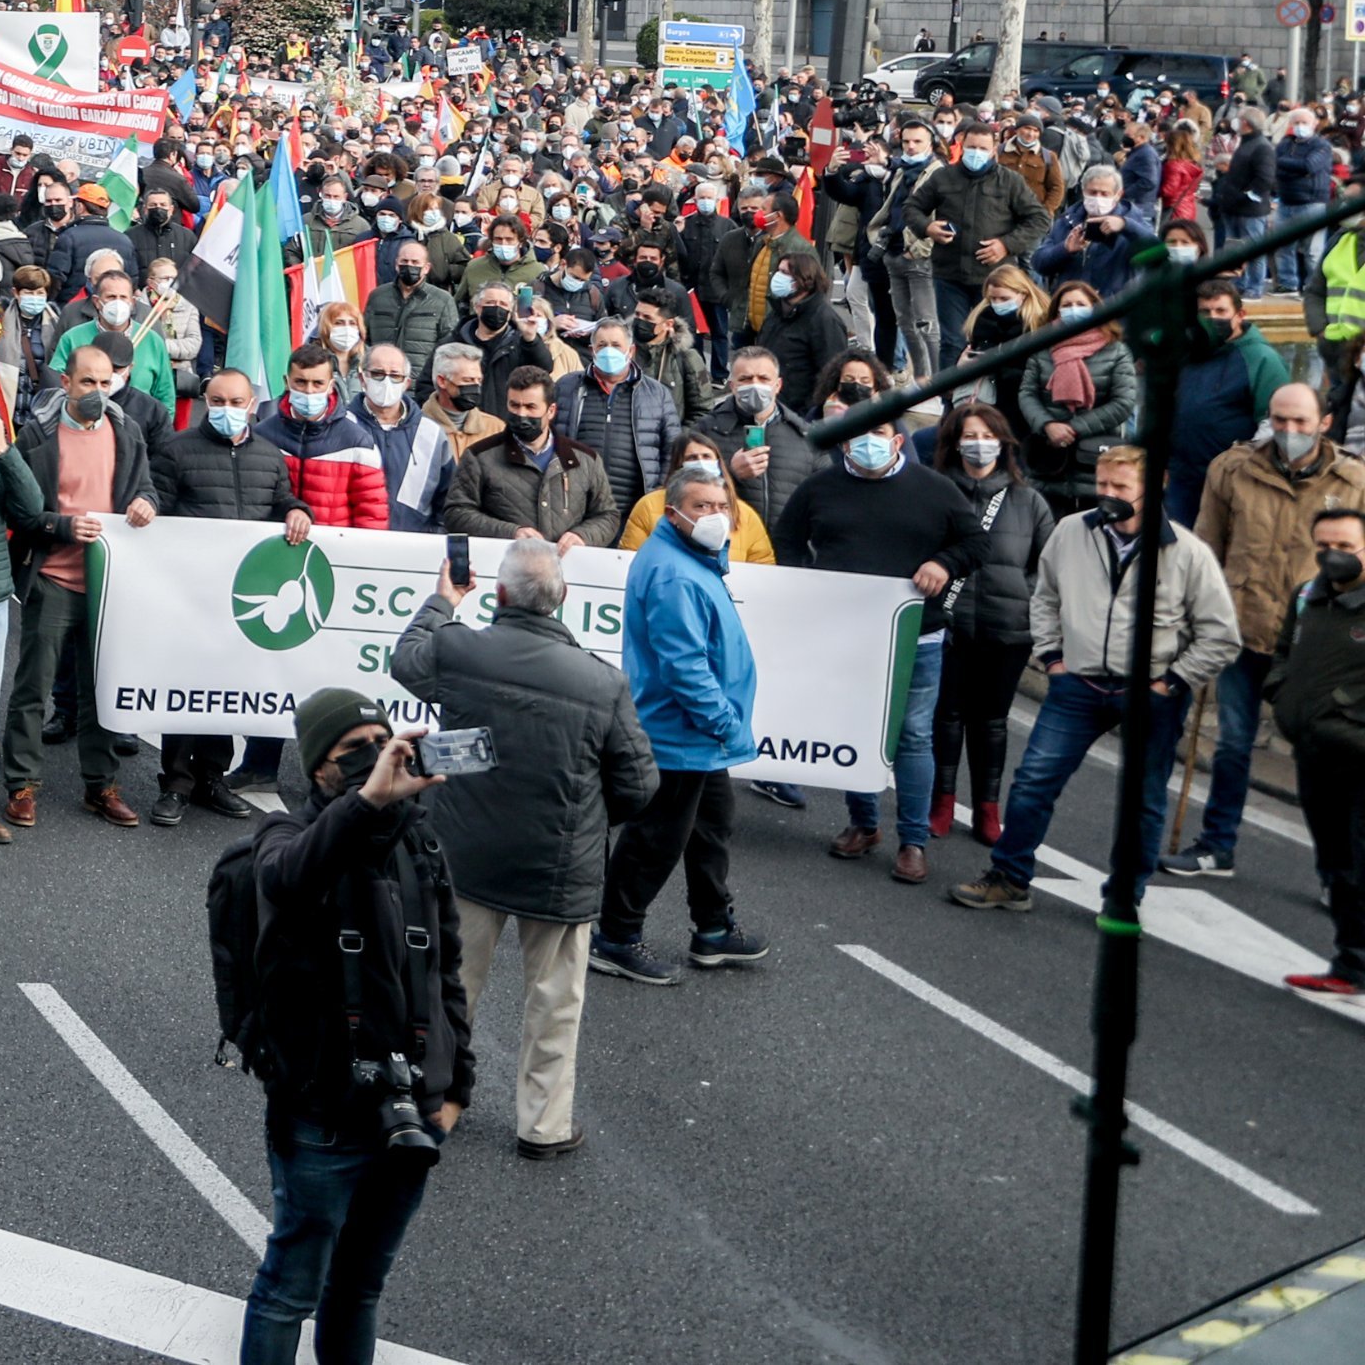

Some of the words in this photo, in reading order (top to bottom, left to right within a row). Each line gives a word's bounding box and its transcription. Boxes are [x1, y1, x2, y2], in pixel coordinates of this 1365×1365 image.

[666, 28, 691, 37] Burgos
[116, 93, 132, 108] NO
[38, 101, 81, 121] TRAIDOR
[115, 688, 157, 711] EN
[168, 689, 297, 716] DEFENSA
[757, 736, 858, 767] AMPO
